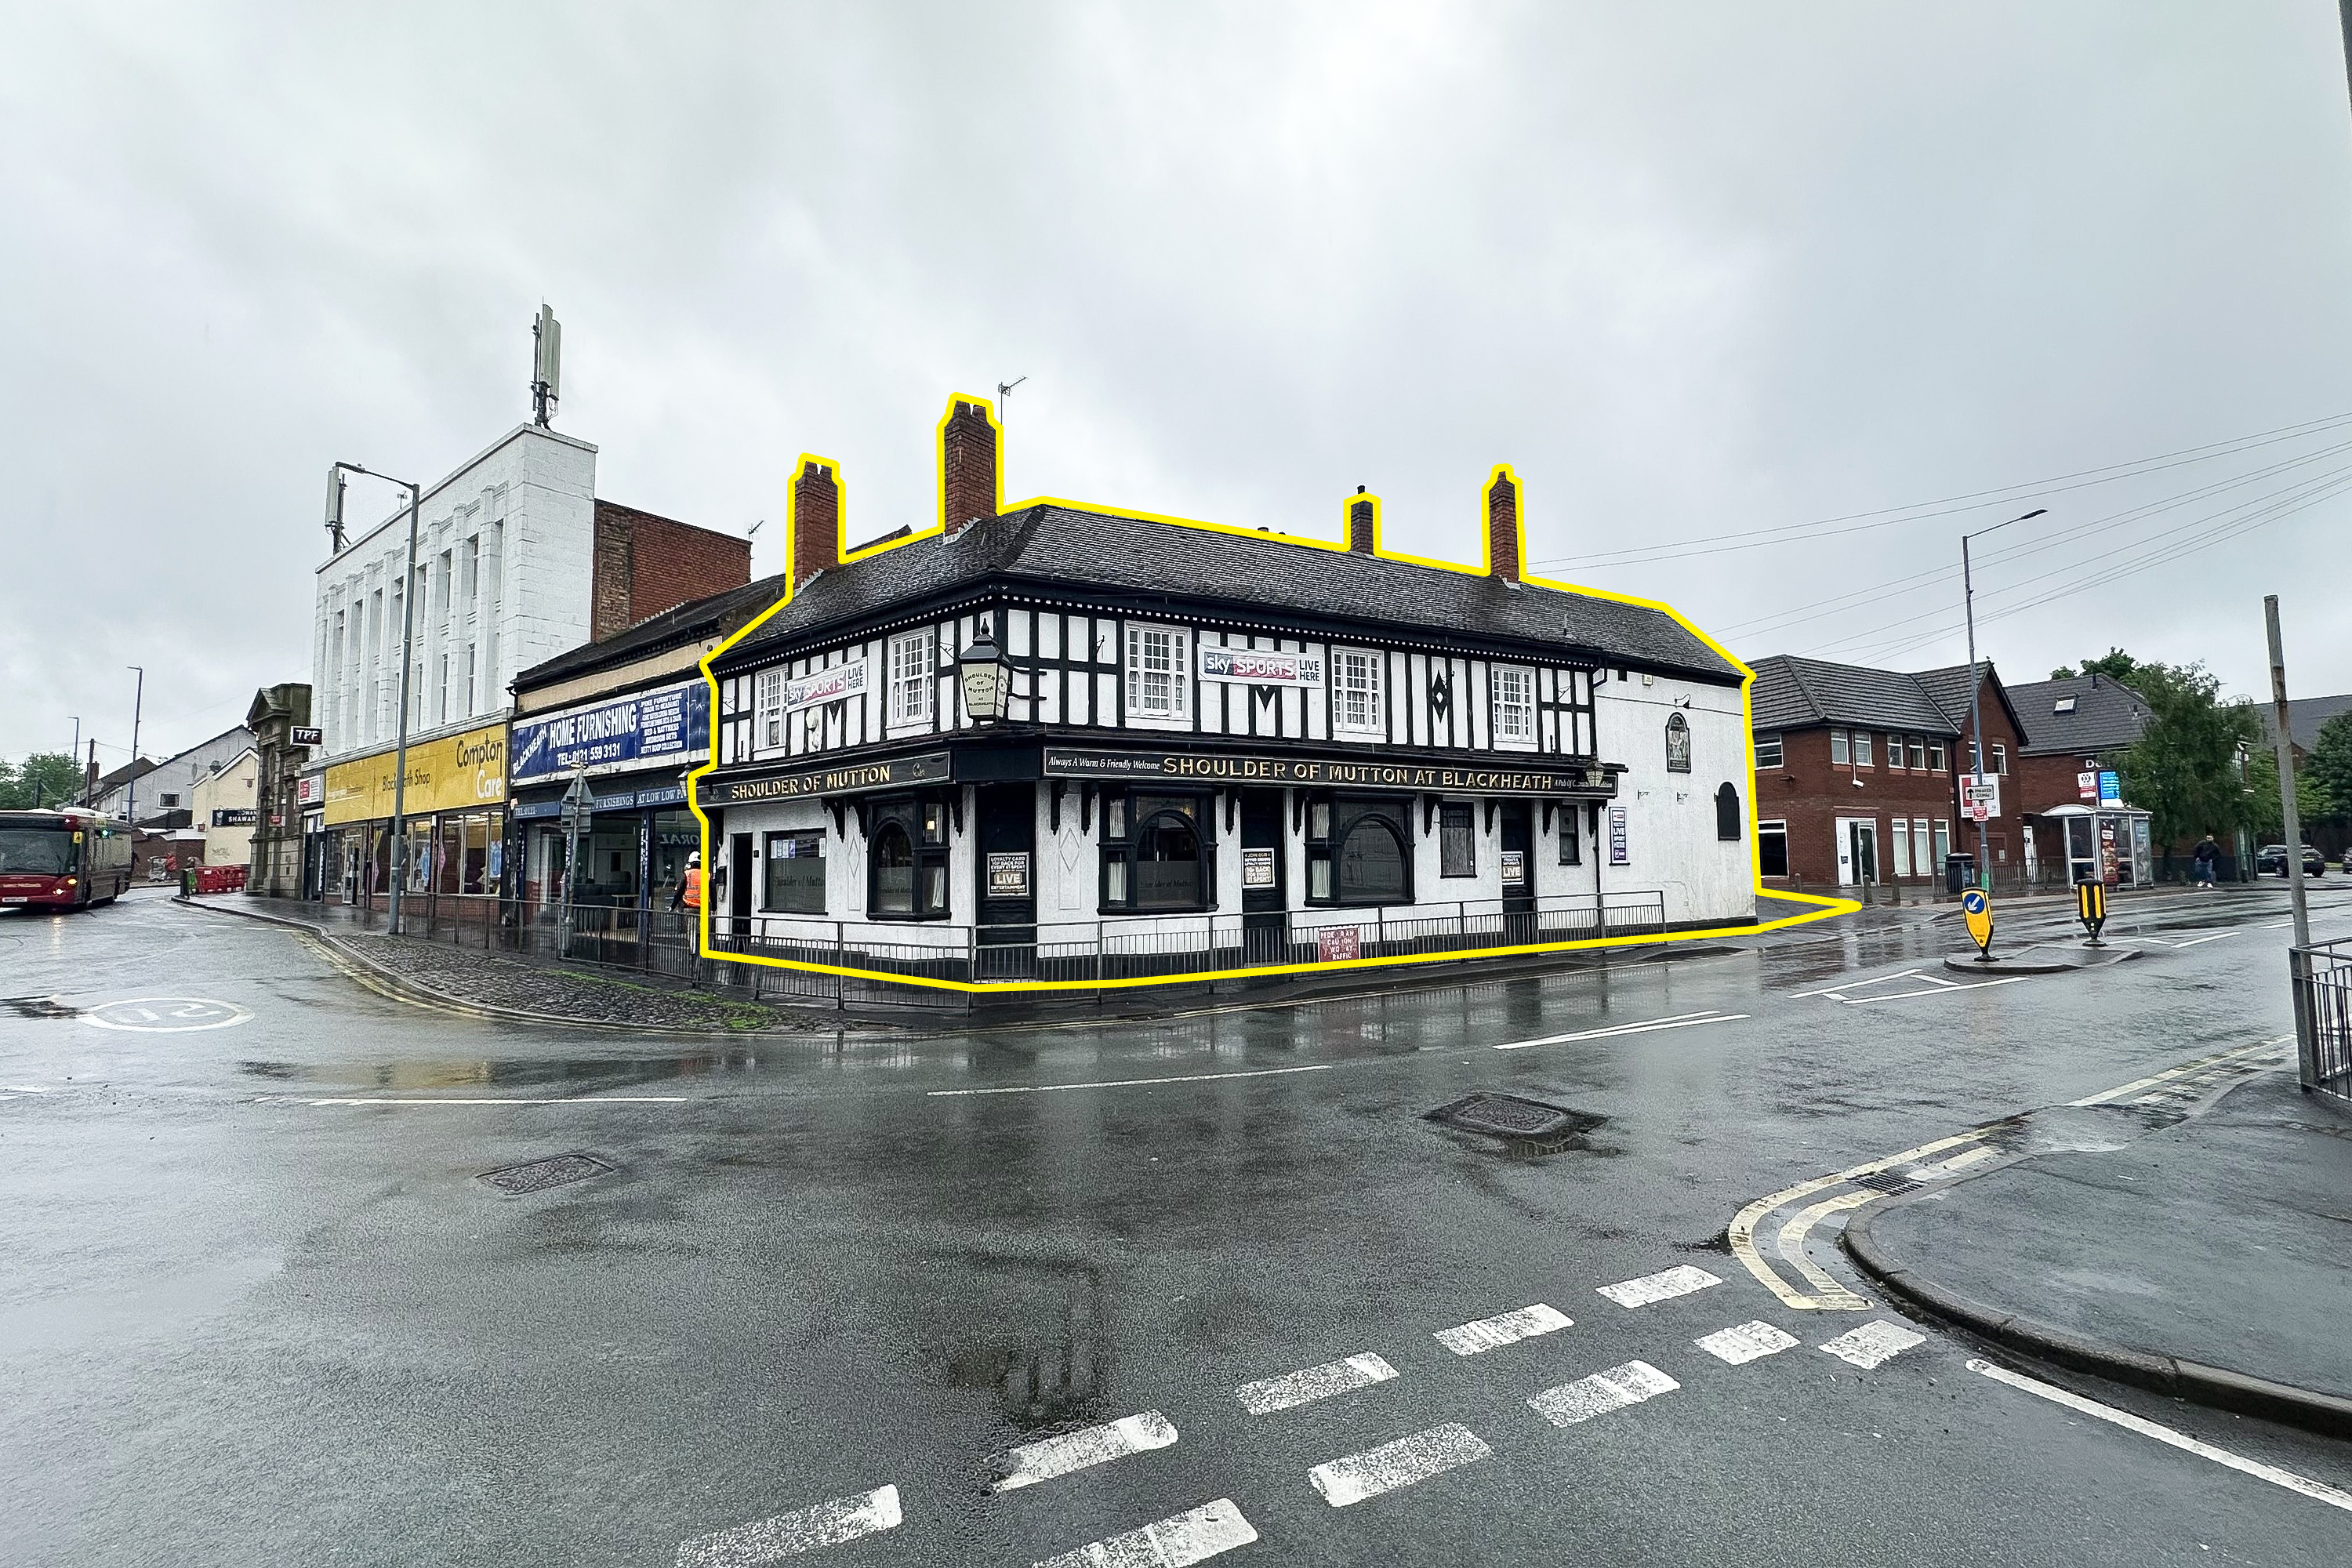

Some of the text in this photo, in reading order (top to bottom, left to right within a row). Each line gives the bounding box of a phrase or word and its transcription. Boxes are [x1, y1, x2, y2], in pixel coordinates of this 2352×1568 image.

[848, 664, 863, 680] LIVE
[1207, 654, 1294, 677] sky SPORTS
[1299, 659, 1319, 671] LIVE
[848, 677, 863, 691] HERE
[965, 673, 995, 683] SHOULDER
[1299, 671, 1319, 681] HERE
[789, 673, 846, 702] sky SPORTS
[968, 685, 994, 694] MUTTON
[296, 729, 320, 741] TPF
[549, 720, 575, 750] HOME
[576, 703, 637, 743] FURNISHING
[456, 733, 504, 777] Compton
[513, 727, 547, 775] BLACKHEATH
[590, 746, 604, 761] 559
[603, 742, 621, 758] 3131
[1048, 756, 1160, 771] Always A Warm & Friendly Welcome
[415, 768, 430, 787] Shop
[1163, 757, 1552, 789] SHOULDER OF MUTTON AT BLACKHEATH
[477, 769, 503, 799] Care
[731, 764, 891, 800] SHOULDER OF MUTTON
[595, 794, 634, 810] FURNISHINGS
[637, 793, 646, 804] AT
[646, 791, 660, 804] LOW
[661, 789, 675, 801] LOW
[1613, 827, 1625, 836] LIVE
[996, 873, 1021, 885] LIVE
[1503, 866, 1521, 877] LIVE
